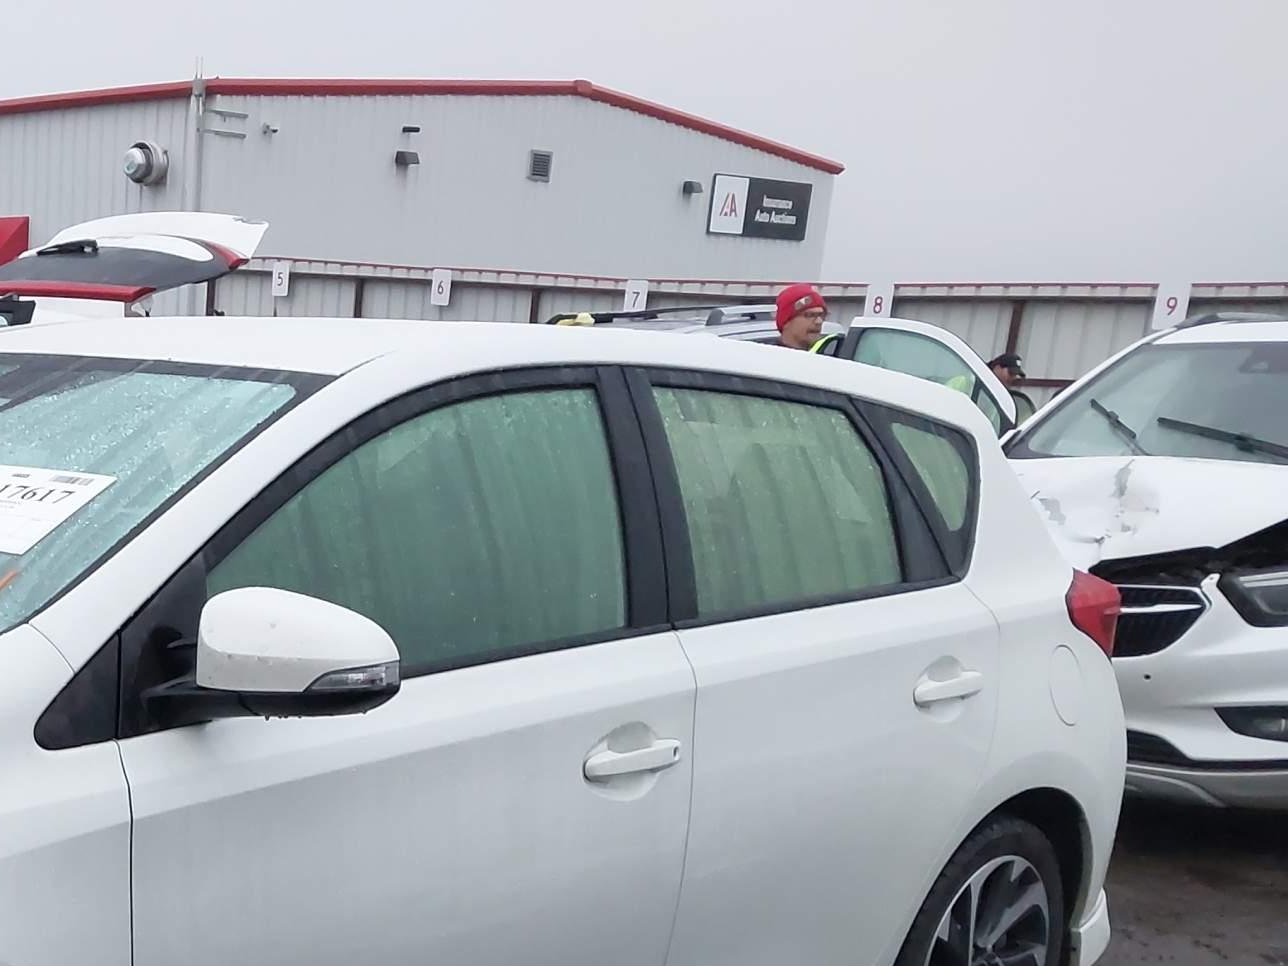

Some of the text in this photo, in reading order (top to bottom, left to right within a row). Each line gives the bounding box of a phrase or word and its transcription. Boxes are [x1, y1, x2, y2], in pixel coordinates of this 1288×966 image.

[277, 271, 284, 286] 5
[437, 280, 444, 295] 6
[632, 291, 640, 308] 7
[873, 296, 883, 314] 8
[1166, 297, 1178, 316] 9
